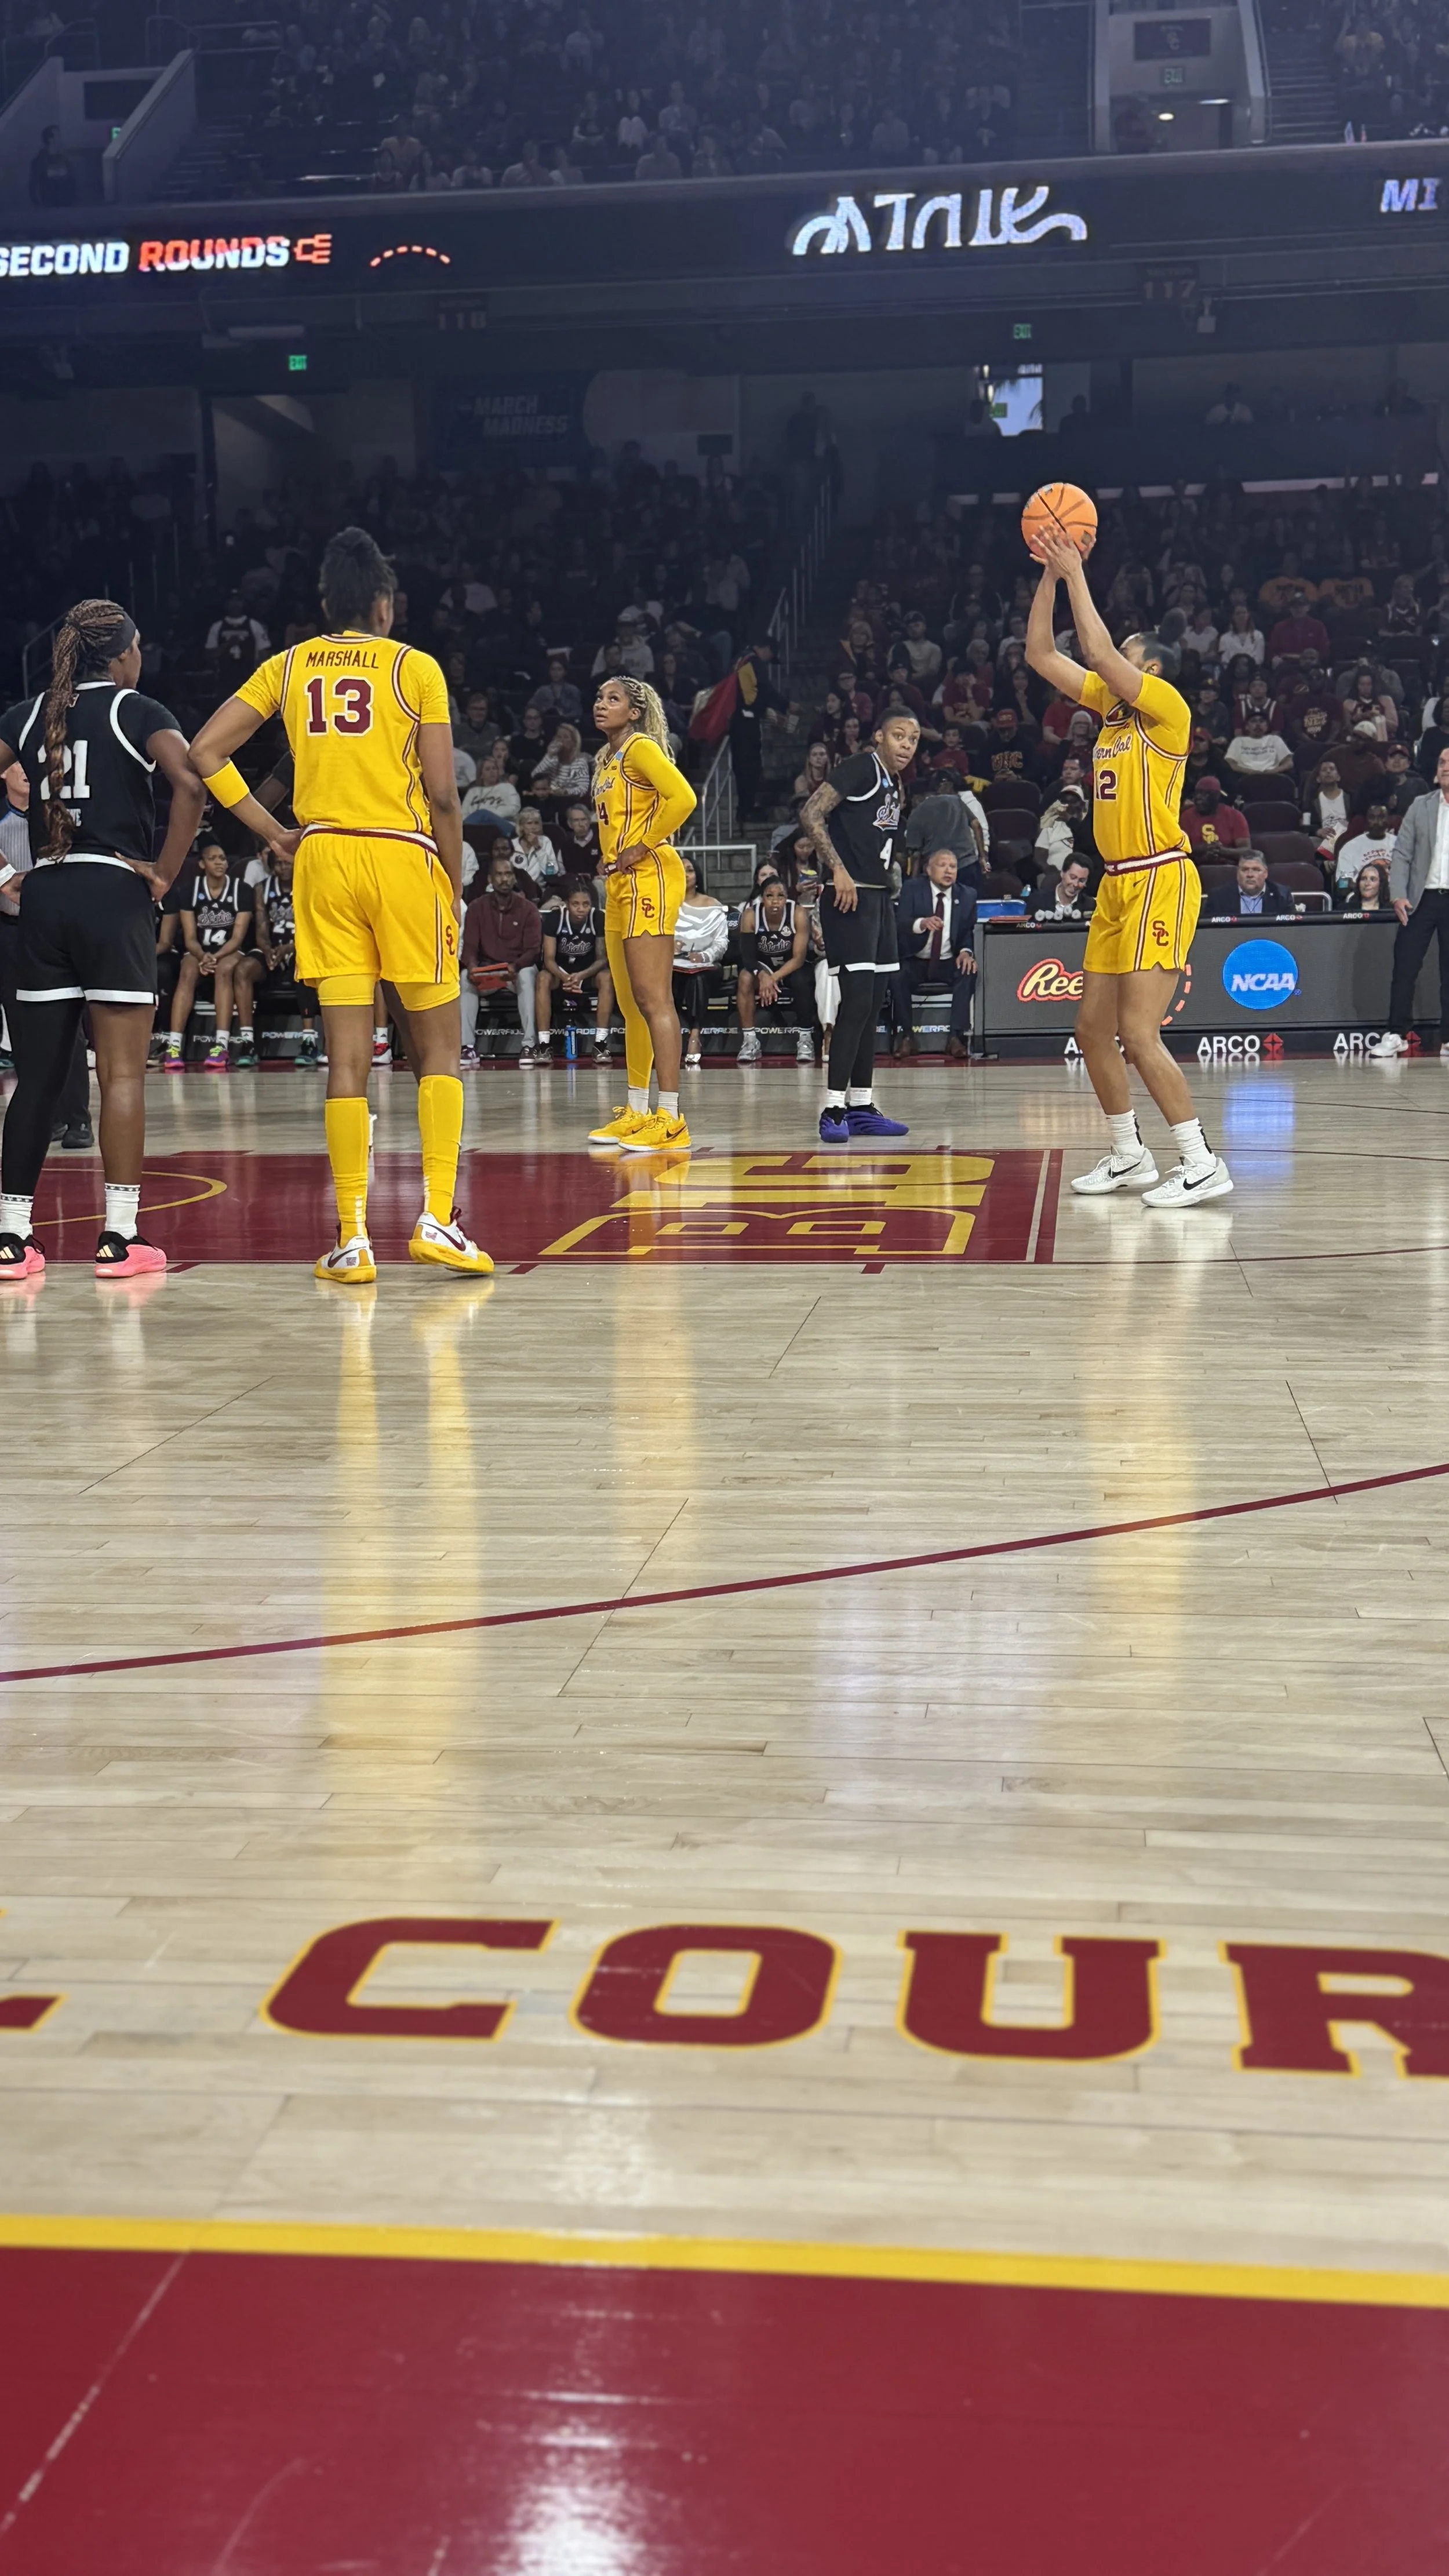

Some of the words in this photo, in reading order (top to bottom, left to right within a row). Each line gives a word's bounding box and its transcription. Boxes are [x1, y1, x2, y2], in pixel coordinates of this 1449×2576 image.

[1380, 178, 1439, 212] MI
[138, 235, 290, 272] ROUNDS
[1144, 279, 1197, 299] 117
[474, 394, 538, 415] MARCH
[482, 414, 569, 438] MADNESS
[306, 649, 379, 668] MARSHALL
[305, 675, 374, 737] 13
[879, 838, 893, 870] 4
[203, 929, 228, 946] 14
[1152, 920, 1169, 947] SC
[1230, 973, 1296, 992] NCAA
[1197, 1035, 1261, 1054] ARCO
[1333, 1032, 1381, 1050] ARC
[259, 1916, 1449, 2079] COUR
